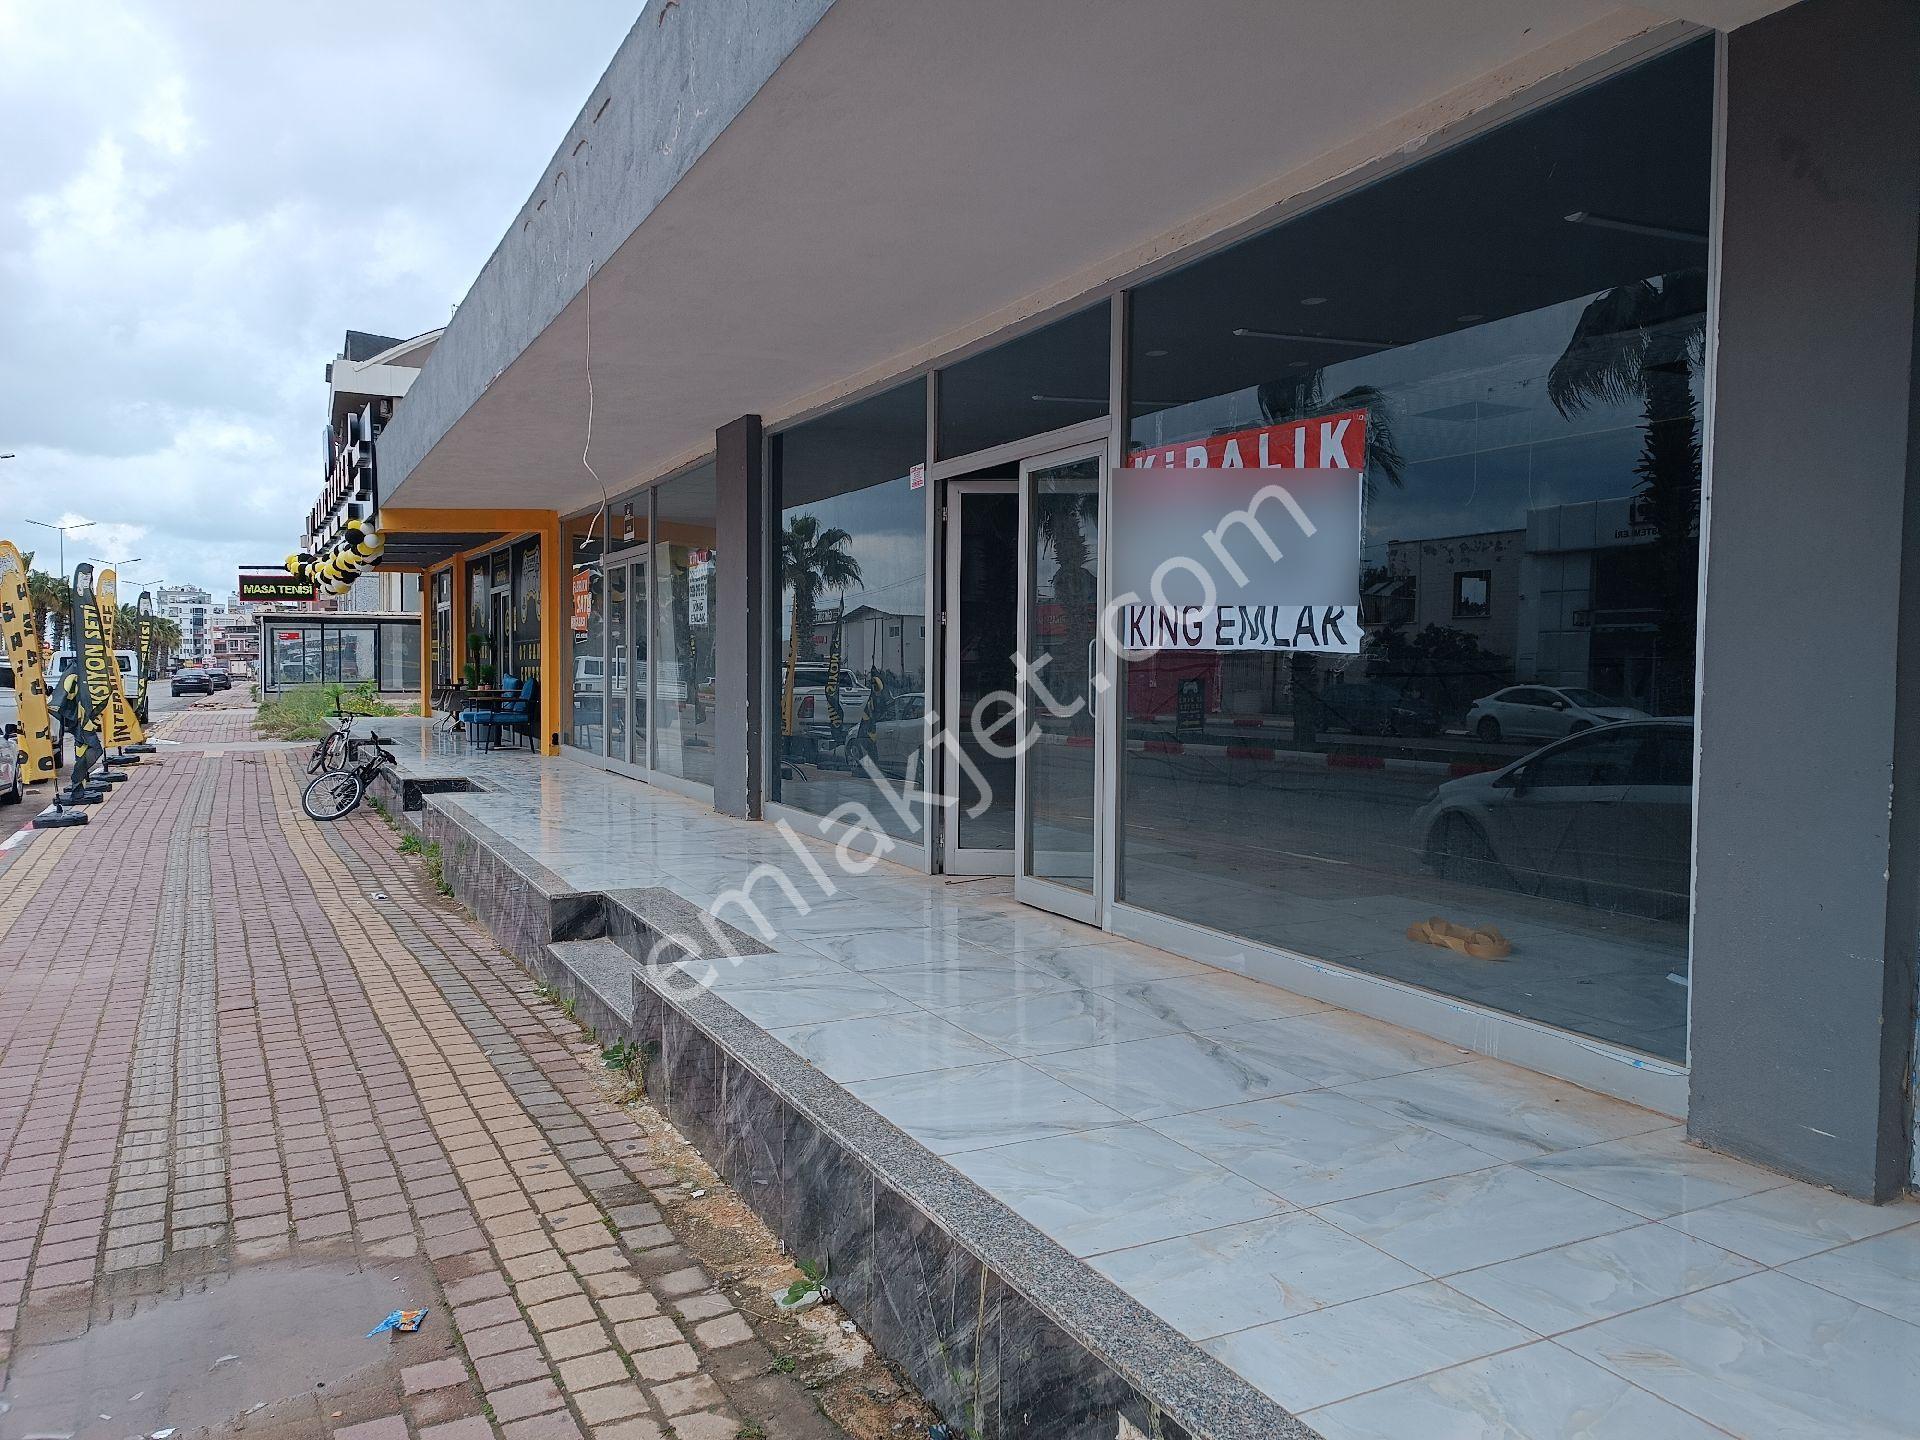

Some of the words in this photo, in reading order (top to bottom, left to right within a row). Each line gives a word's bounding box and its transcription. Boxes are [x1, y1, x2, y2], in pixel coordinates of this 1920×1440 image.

[243, 584, 277, 594] MASA
[277, 583, 313, 594] TENİSİ
[1130, 606, 1203, 647] KING
